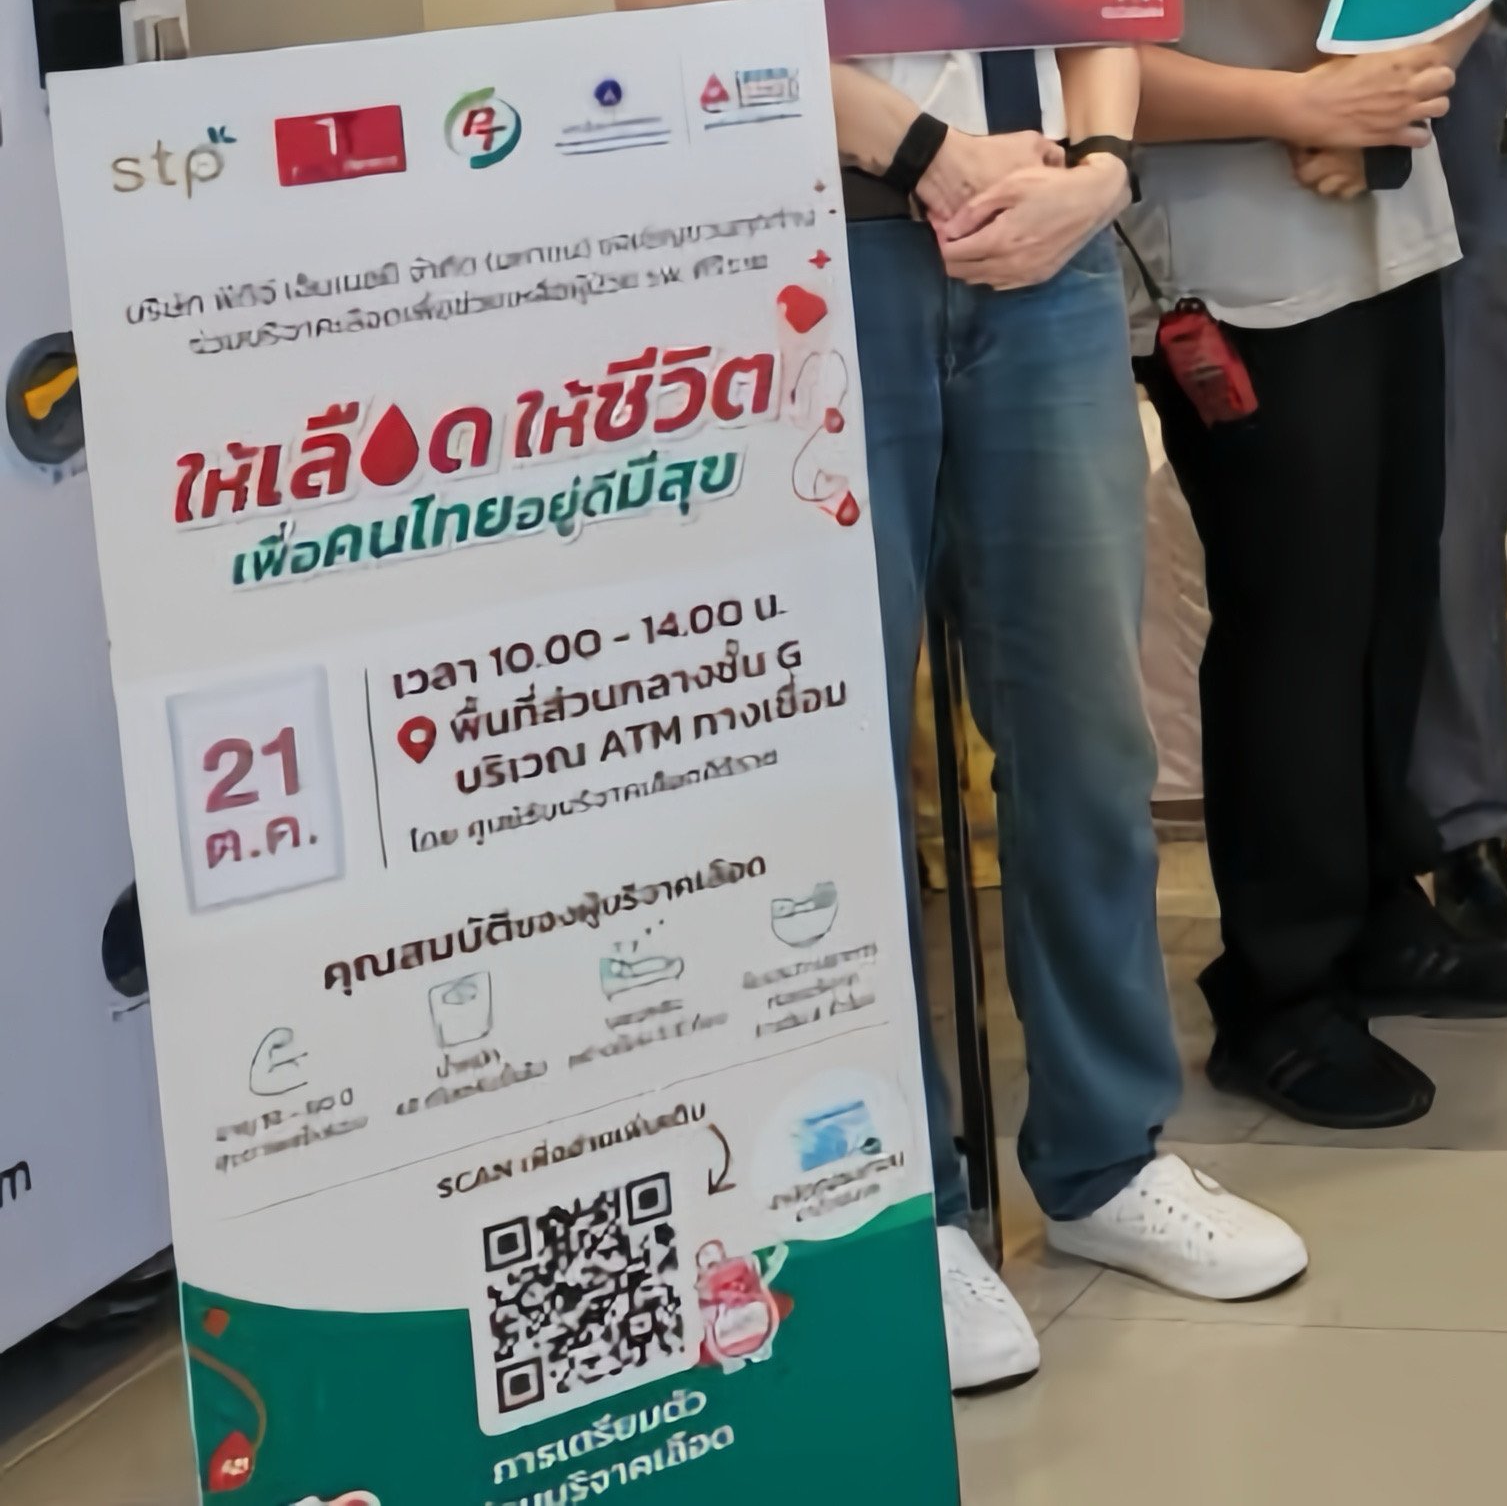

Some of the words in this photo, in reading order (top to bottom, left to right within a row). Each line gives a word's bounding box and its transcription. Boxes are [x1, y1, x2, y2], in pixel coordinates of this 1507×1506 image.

[111, 139, 225, 199] stp
[513, 345, 776, 460] ให้ชีวิต
[231, 450, 740, 586] เพื่อคนไทยอยู่ดีมีสุข
[393, 658, 478, 700] เวลา
[488, 627, 602, 676] 10.00
[641, 598, 744, 645] 14.00
[776, 639, 802, 670] G
[202, 726, 301, 814] 21
[454, 741, 587, 796] บริเวณ
[599, 714, 683, 763] ATM
[205, 815, 319, 870] ต.ค.
[436, 1158, 514, 1199] SCAN
